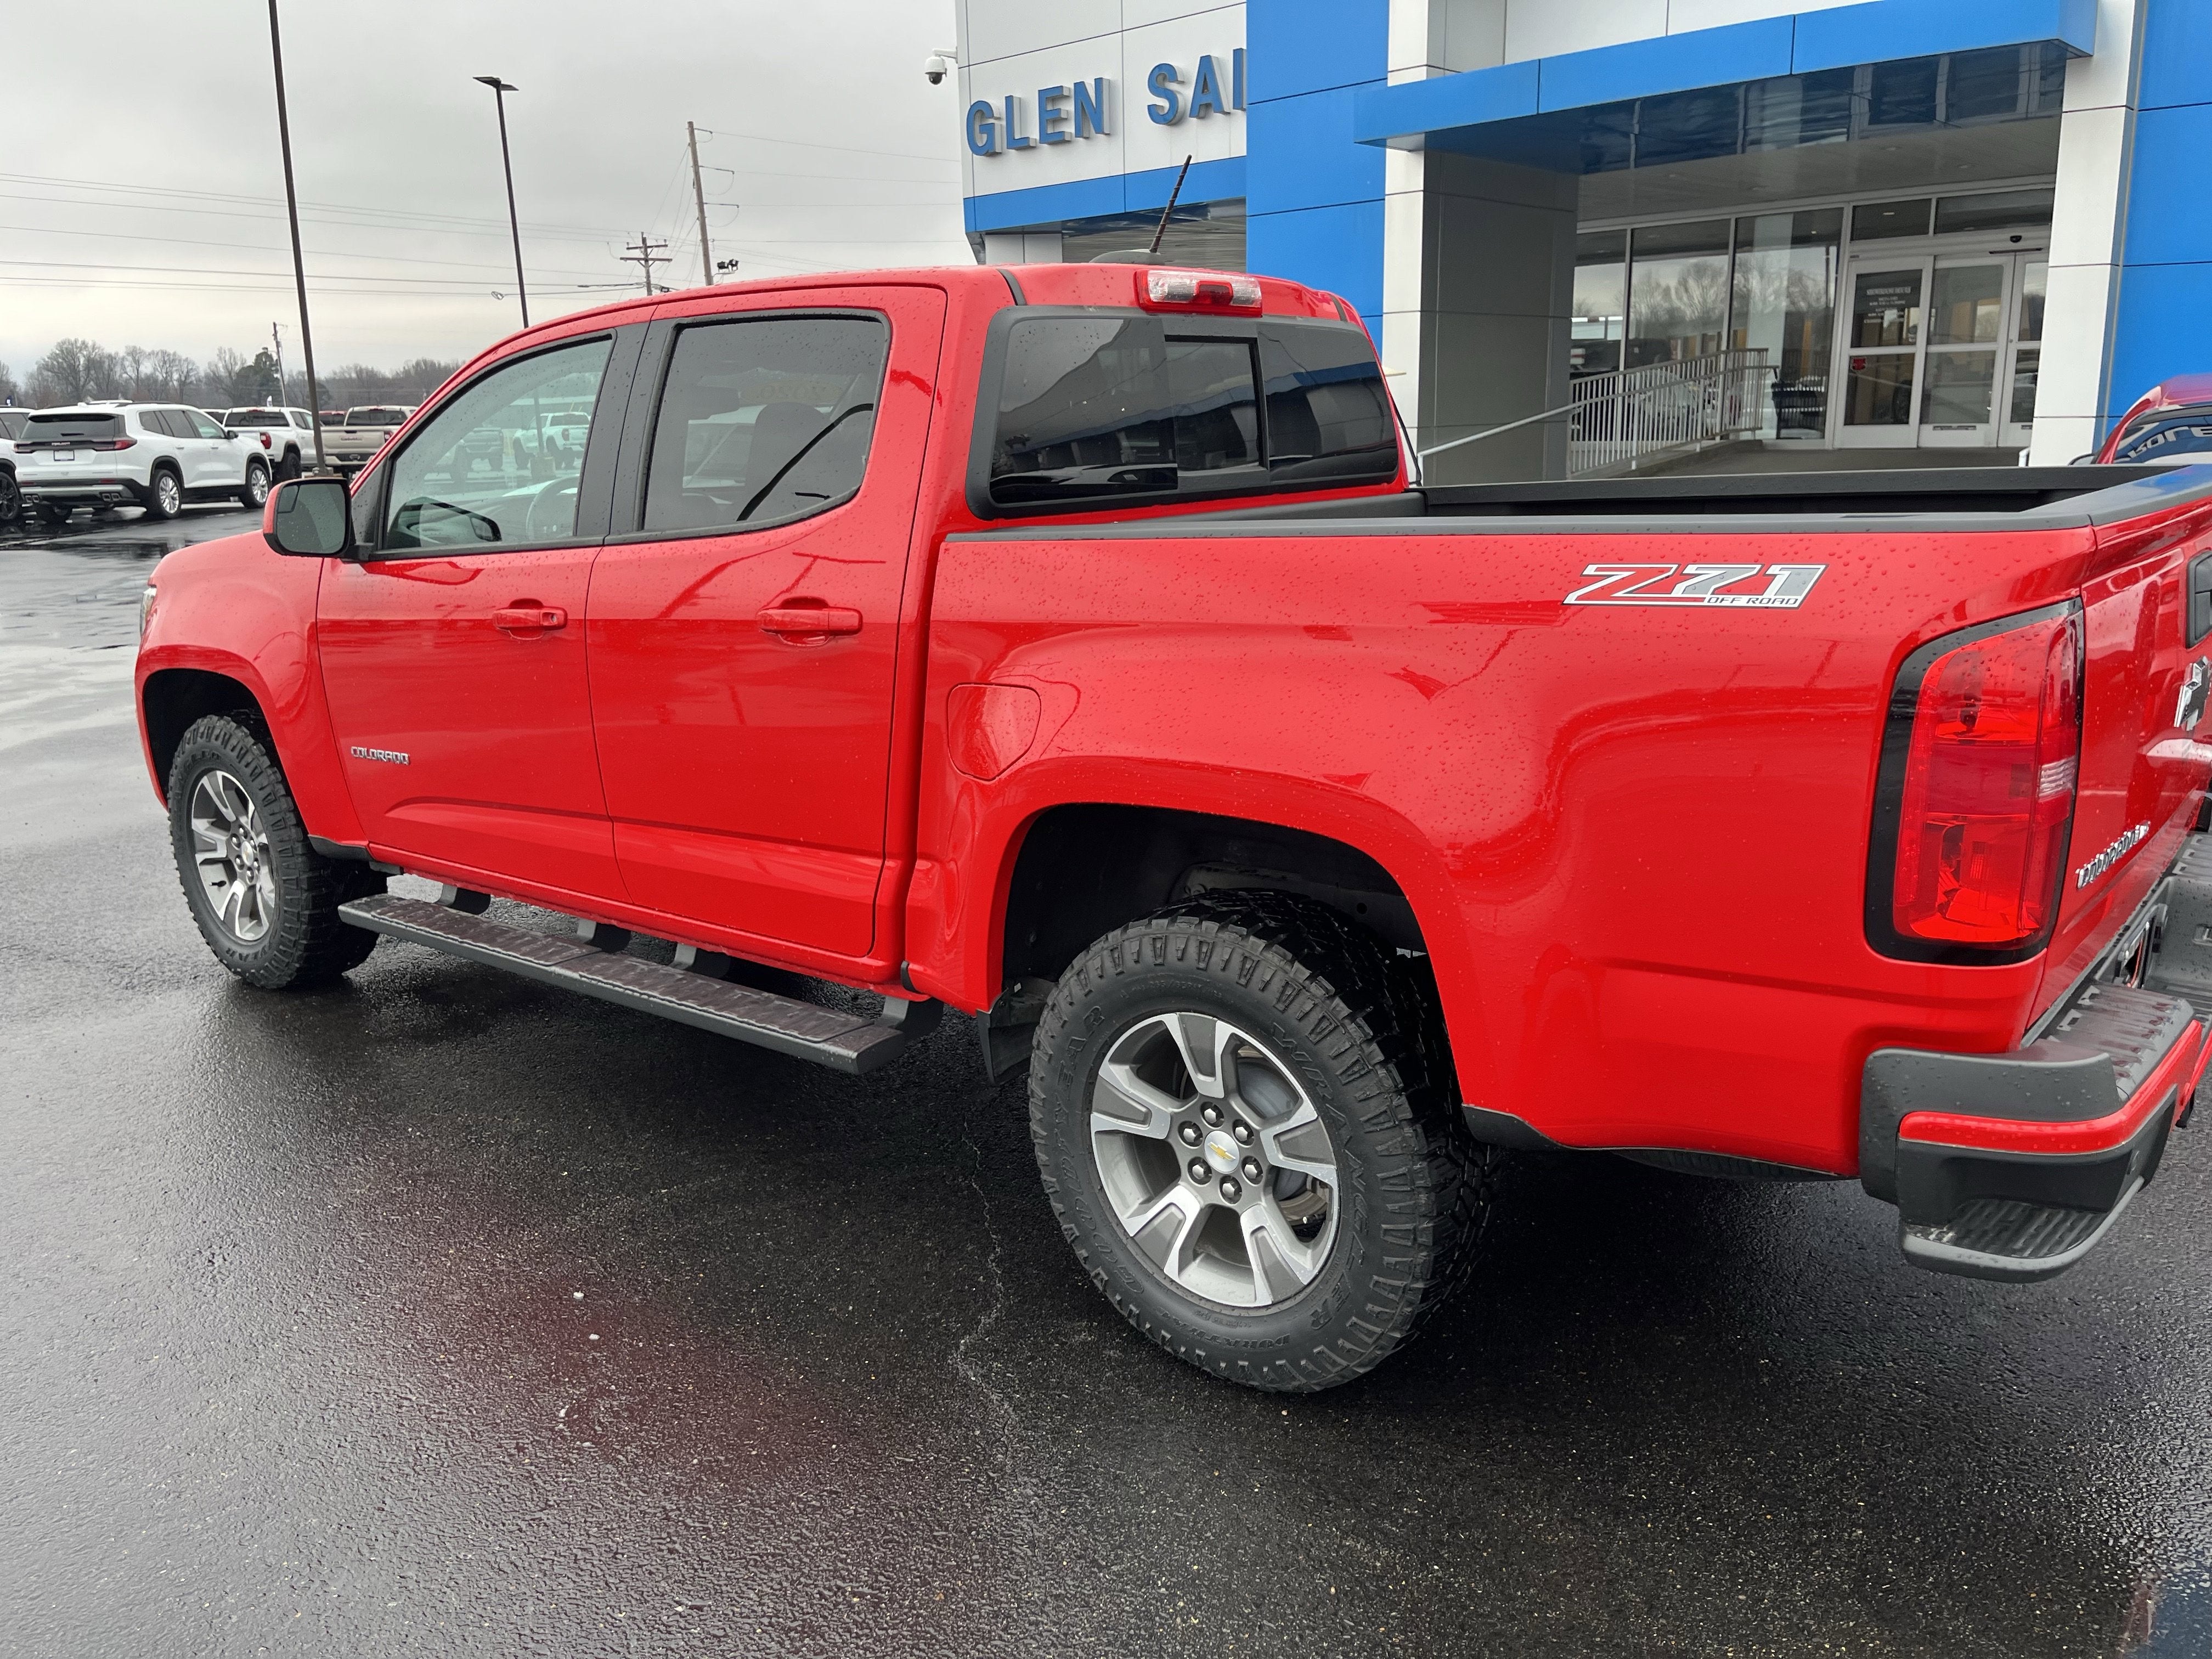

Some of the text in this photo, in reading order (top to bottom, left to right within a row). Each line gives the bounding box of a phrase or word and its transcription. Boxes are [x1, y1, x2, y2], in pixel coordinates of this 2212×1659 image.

[967, 77, 1110, 156] GLEN
[1562, 563, 1830, 609] Z71
[351, 746, 411, 766] COLORADO
[1271, 1022, 1369, 1330] WRANGLER
